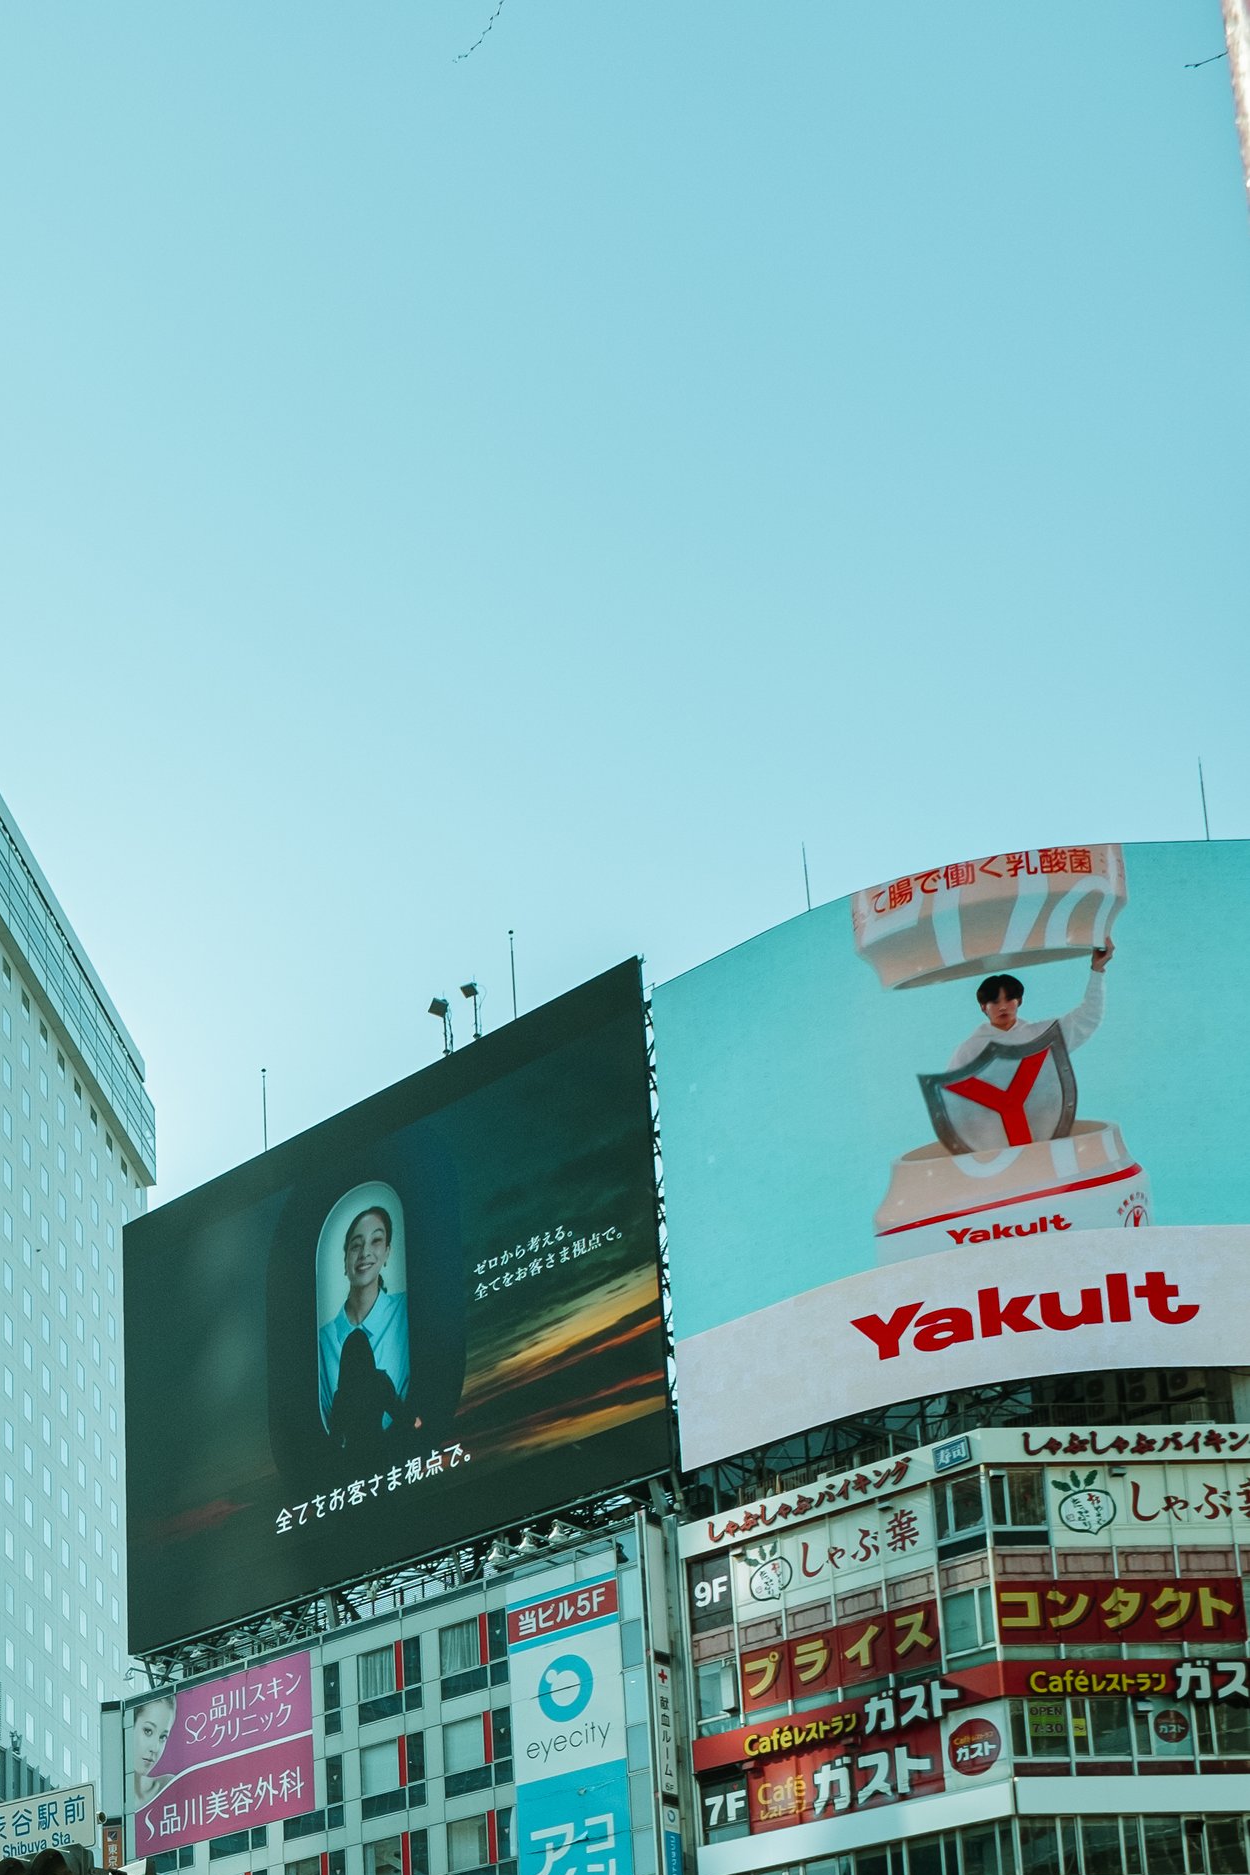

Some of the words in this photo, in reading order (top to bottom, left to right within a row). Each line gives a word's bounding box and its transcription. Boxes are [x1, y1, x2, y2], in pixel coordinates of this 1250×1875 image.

[473, 1224, 573, 1275] ゼロから考える。
[946, 1213, 1072, 1245] Yakult
[474, 1226, 623, 1301] 全てをお客さま視点で。
[850, 1271, 1200, 1360] Yakult
[275, 1443, 472, 1535] 全てをお客さま視点で。
[707, 1456, 913, 1543] しゃぶしゃぶバイキング
[801, 1509, 920, 1578] しゃぶ葉
[517, 1587, 607, 1637] 当ビル5F
[694, 1576, 729, 1607] 9F
[999, 1587, 1235, 1629] コンタクト
[744, 1610, 934, 1698] プライス
[209, 1672, 302, 1722] 品川スキン
[1029, 1669, 1166, 1693] Caféレストラン
[209, 1702, 292, 1748] クリニック
[743, 1712, 857, 1757] Caféレストラン
[864, 1681, 959, 1735] ガスト
[1029, 1706, 1063, 1716] OPEN
[526, 1721, 612, 1763] eyecity
[659, 1696, 674, 1778] 献血ルーム
[956, 1741, 997, 1763] ガスト
[159, 1766, 305, 1838] 品川美容外科
[757, 1774, 807, 1806] Café
[814, 1746, 932, 1817] ガスト
[705, 1789, 746, 1827] 7F
[760, 1799, 807, 1821] レストラン
[2, 1838, 47, 1858] Shibuya
[52, 1832, 75, 1849] Sta.
